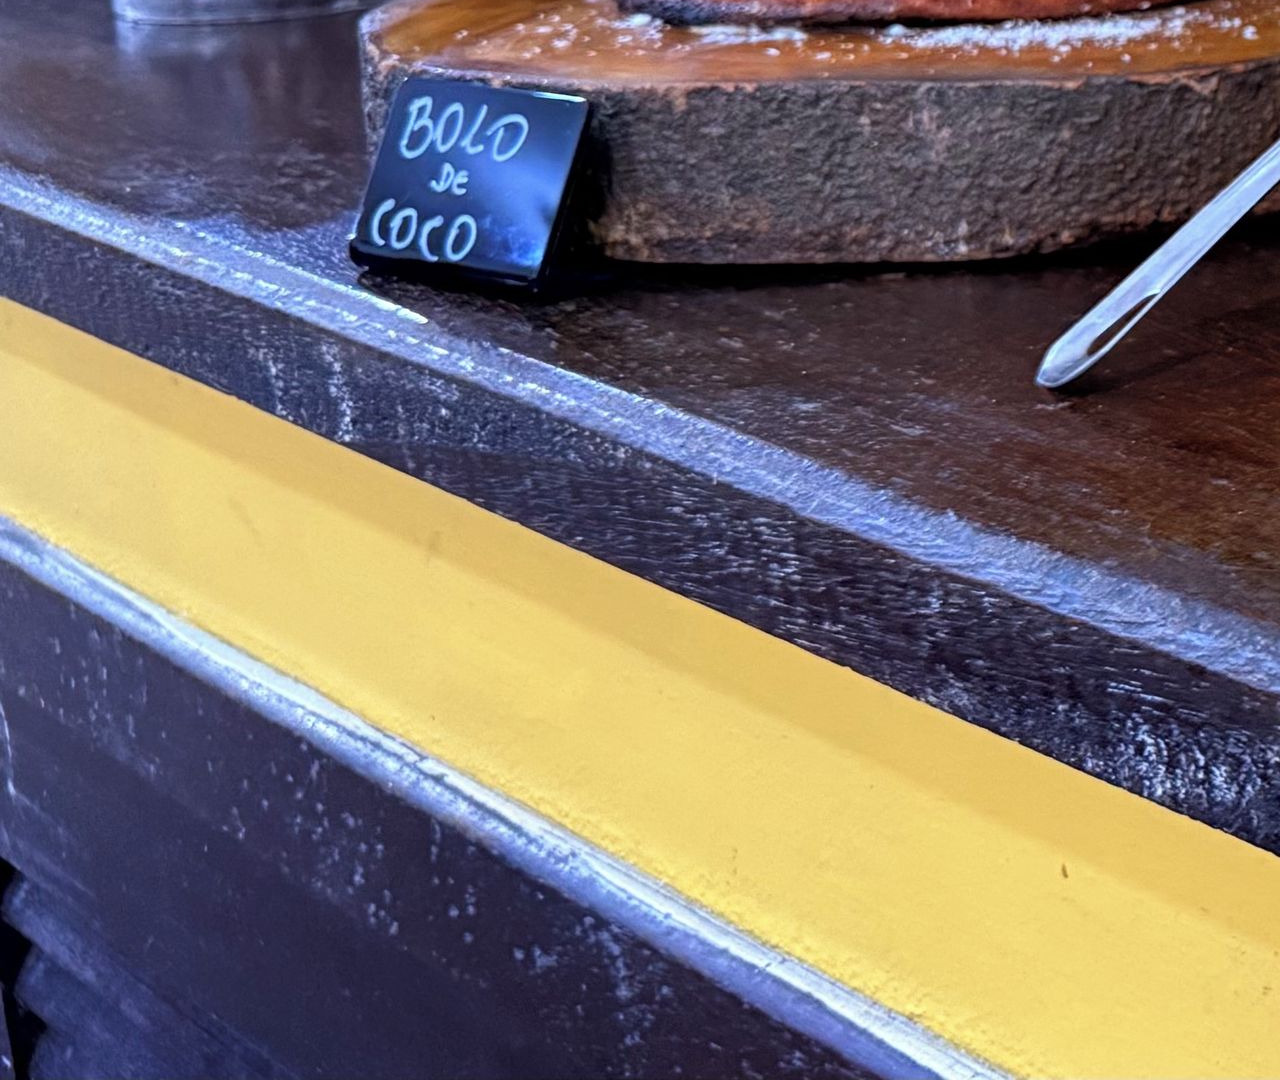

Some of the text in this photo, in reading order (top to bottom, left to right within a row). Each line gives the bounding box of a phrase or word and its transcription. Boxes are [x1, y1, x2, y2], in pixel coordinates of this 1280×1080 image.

[399, 95, 529, 162] BOLO
[430, 162, 470, 196] DE
[370, 198, 477, 263] COCO
